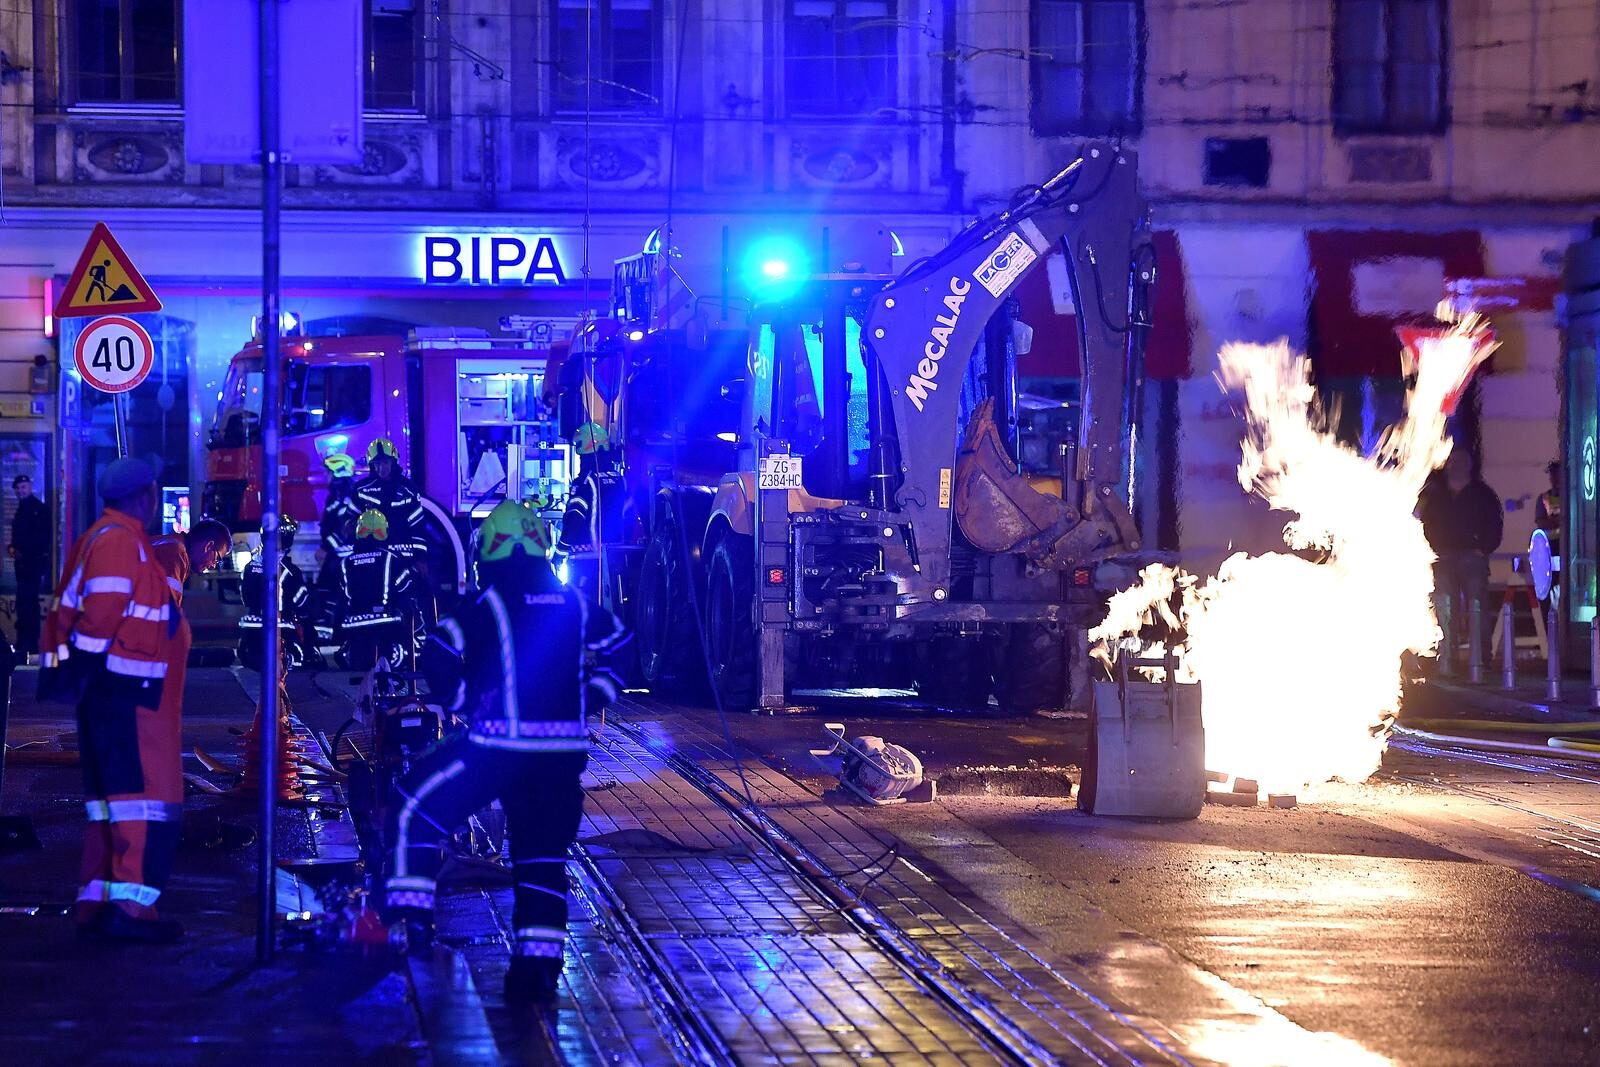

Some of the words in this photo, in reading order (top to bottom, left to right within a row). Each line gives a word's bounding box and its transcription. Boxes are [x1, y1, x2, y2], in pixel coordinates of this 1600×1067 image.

[425, 236, 567, 284] BIPA
[980, 238, 1023, 283] LAGER
[92, 336, 135, 372] 40
[761, 473, 801, 487] 2384-HC
[773, 460, 789, 473] ZG
